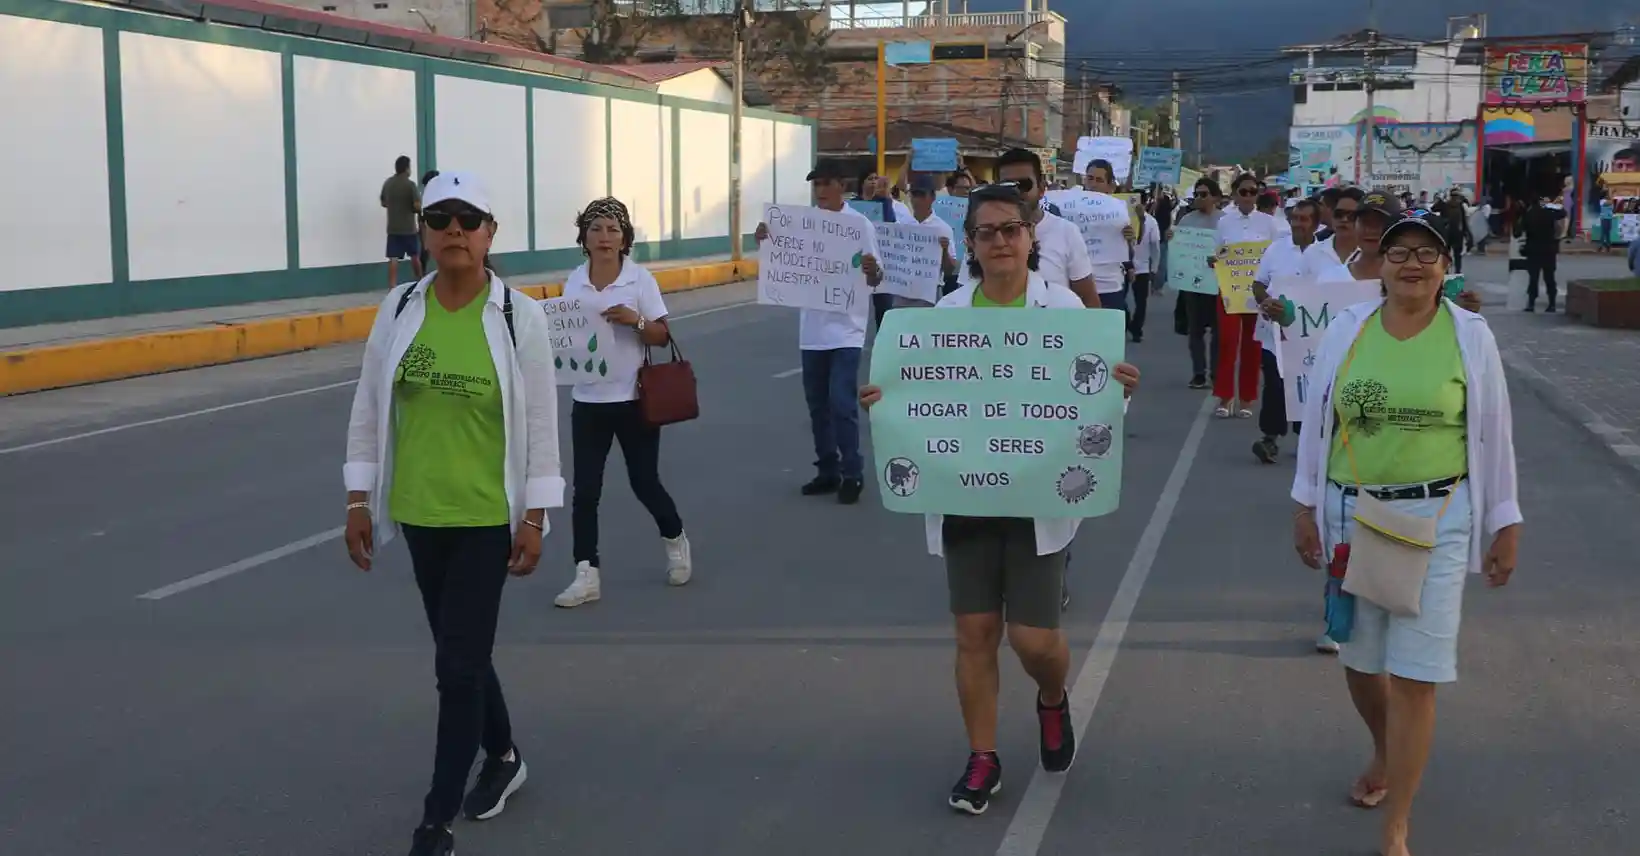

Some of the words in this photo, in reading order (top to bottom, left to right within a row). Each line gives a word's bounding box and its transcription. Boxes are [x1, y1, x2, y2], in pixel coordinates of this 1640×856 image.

[1506, 52, 1564, 73] FERIA
[1501, 74, 1568, 96] PLAZA
[767, 206, 792, 228] POR
[802, 216, 816, 230] UN
[822, 219, 861, 241] FUTURO
[768, 234, 805, 251] VERDE
[813, 240, 825, 253] NO
[770, 251, 849, 275] MODIFIQUEN
[767, 269, 821, 285] NUESTRA
[559, 299, 581, 313] QUE
[899, 334, 920, 349] LA
[931, 333, 992, 348] TIERRA
[1003, 332, 1029, 346] NO
[1042, 334, 1064, 349] ES
[992, 364, 1014, 378] ES
[1031, 366, 1051, 380] EL
[907, 403, 968, 417] HOGAR
[984, 403, 1007, 417] DE
[1021, 403, 1079, 420] TODOS
[926, 439, 960, 453] LOS
[988, 438, 1045, 454] SERES
[959, 473, 1011, 487] VIVOS
